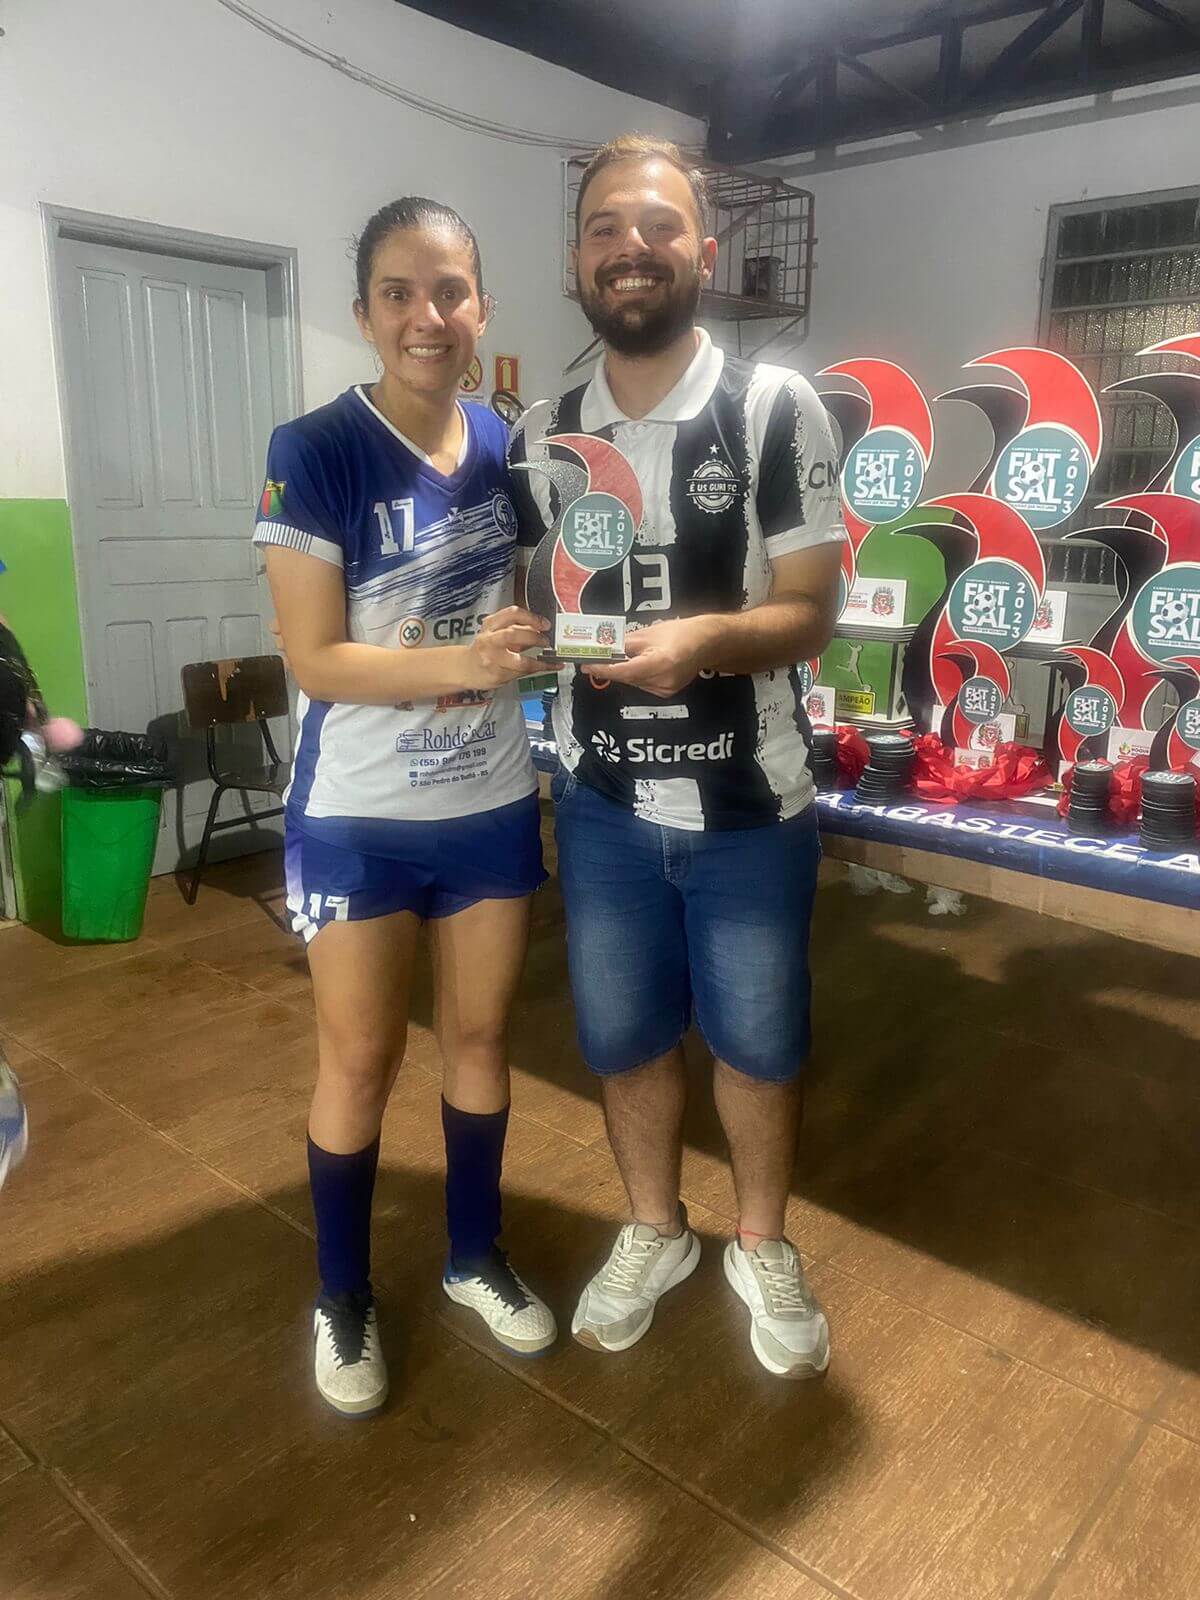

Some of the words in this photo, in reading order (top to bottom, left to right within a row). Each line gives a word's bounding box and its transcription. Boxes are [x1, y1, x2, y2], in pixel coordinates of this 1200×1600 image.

[853, 475, 901, 500] SAL
[1005, 476, 1062, 504] SAL
[373, 498, 414, 555] 17
[573, 530, 615, 549] SAL
[616, 510, 625, 556] 2023
[622, 553, 672, 612] 13
[961, 604, 1011, 630] SAL
[965, 698, 990, 712] SAL
[1072, 708, 1101, 723] SAL
[420, 758, 439, 767] (55)
[473, 747, 487, 757] 199
[626, 732, 735, 763] Sicredi
[308, 893, 349, 920] 17
